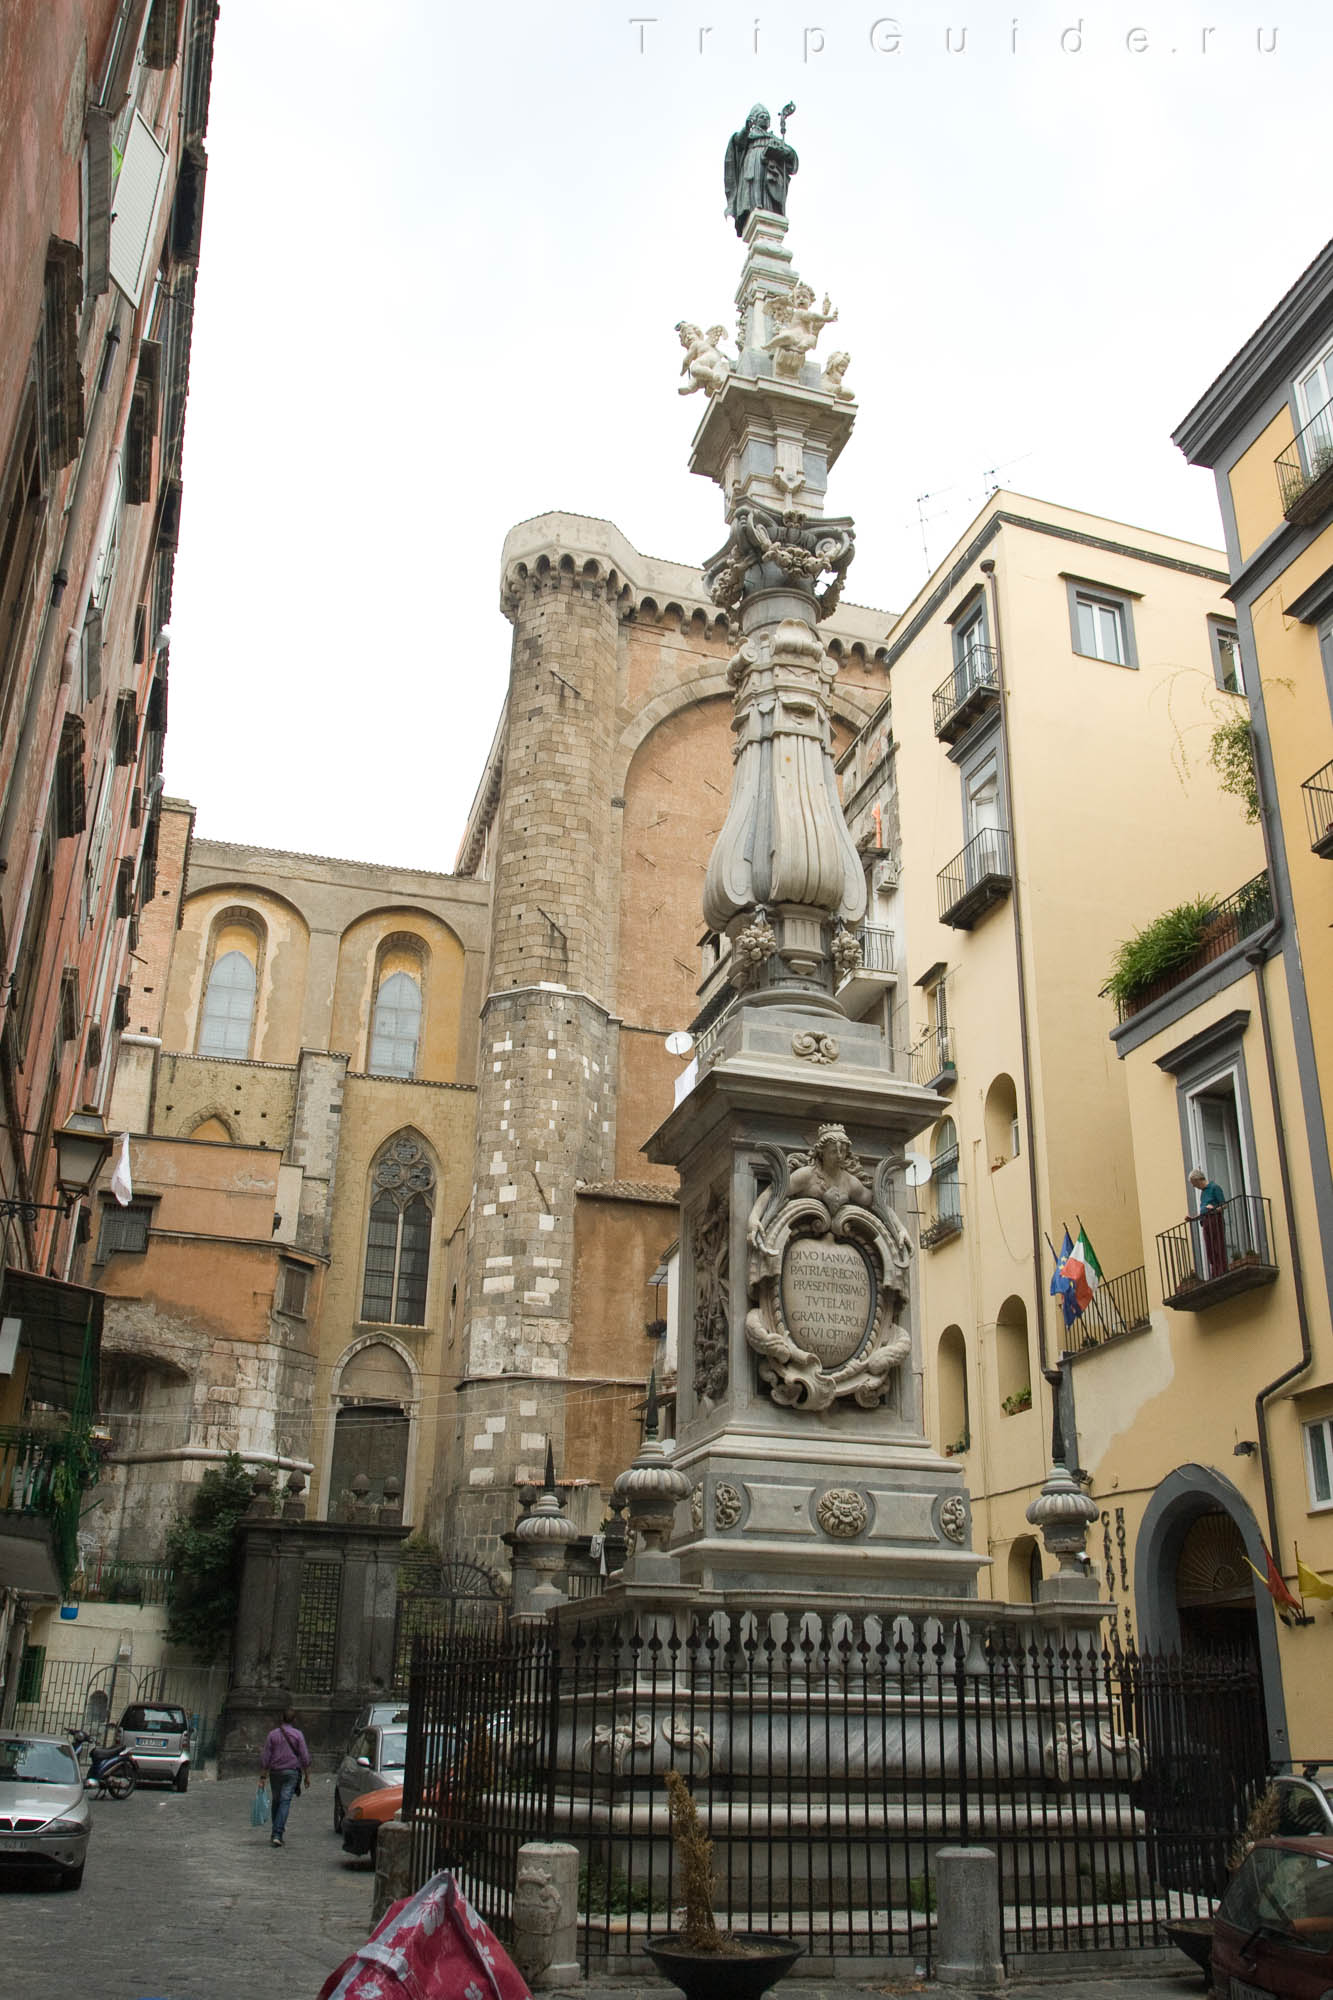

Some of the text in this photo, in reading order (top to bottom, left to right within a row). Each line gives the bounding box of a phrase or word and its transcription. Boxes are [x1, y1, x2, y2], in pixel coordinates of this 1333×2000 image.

[790, 1250, 819, 1261] DIVO
[804, 1295, 856, 1311] TVTELARI
[791, 1311, 826, 1323] GRATA
[799, 1326, 824, 1338] CIVI
[1115, 1507, 1129, 1592] HOTEL
